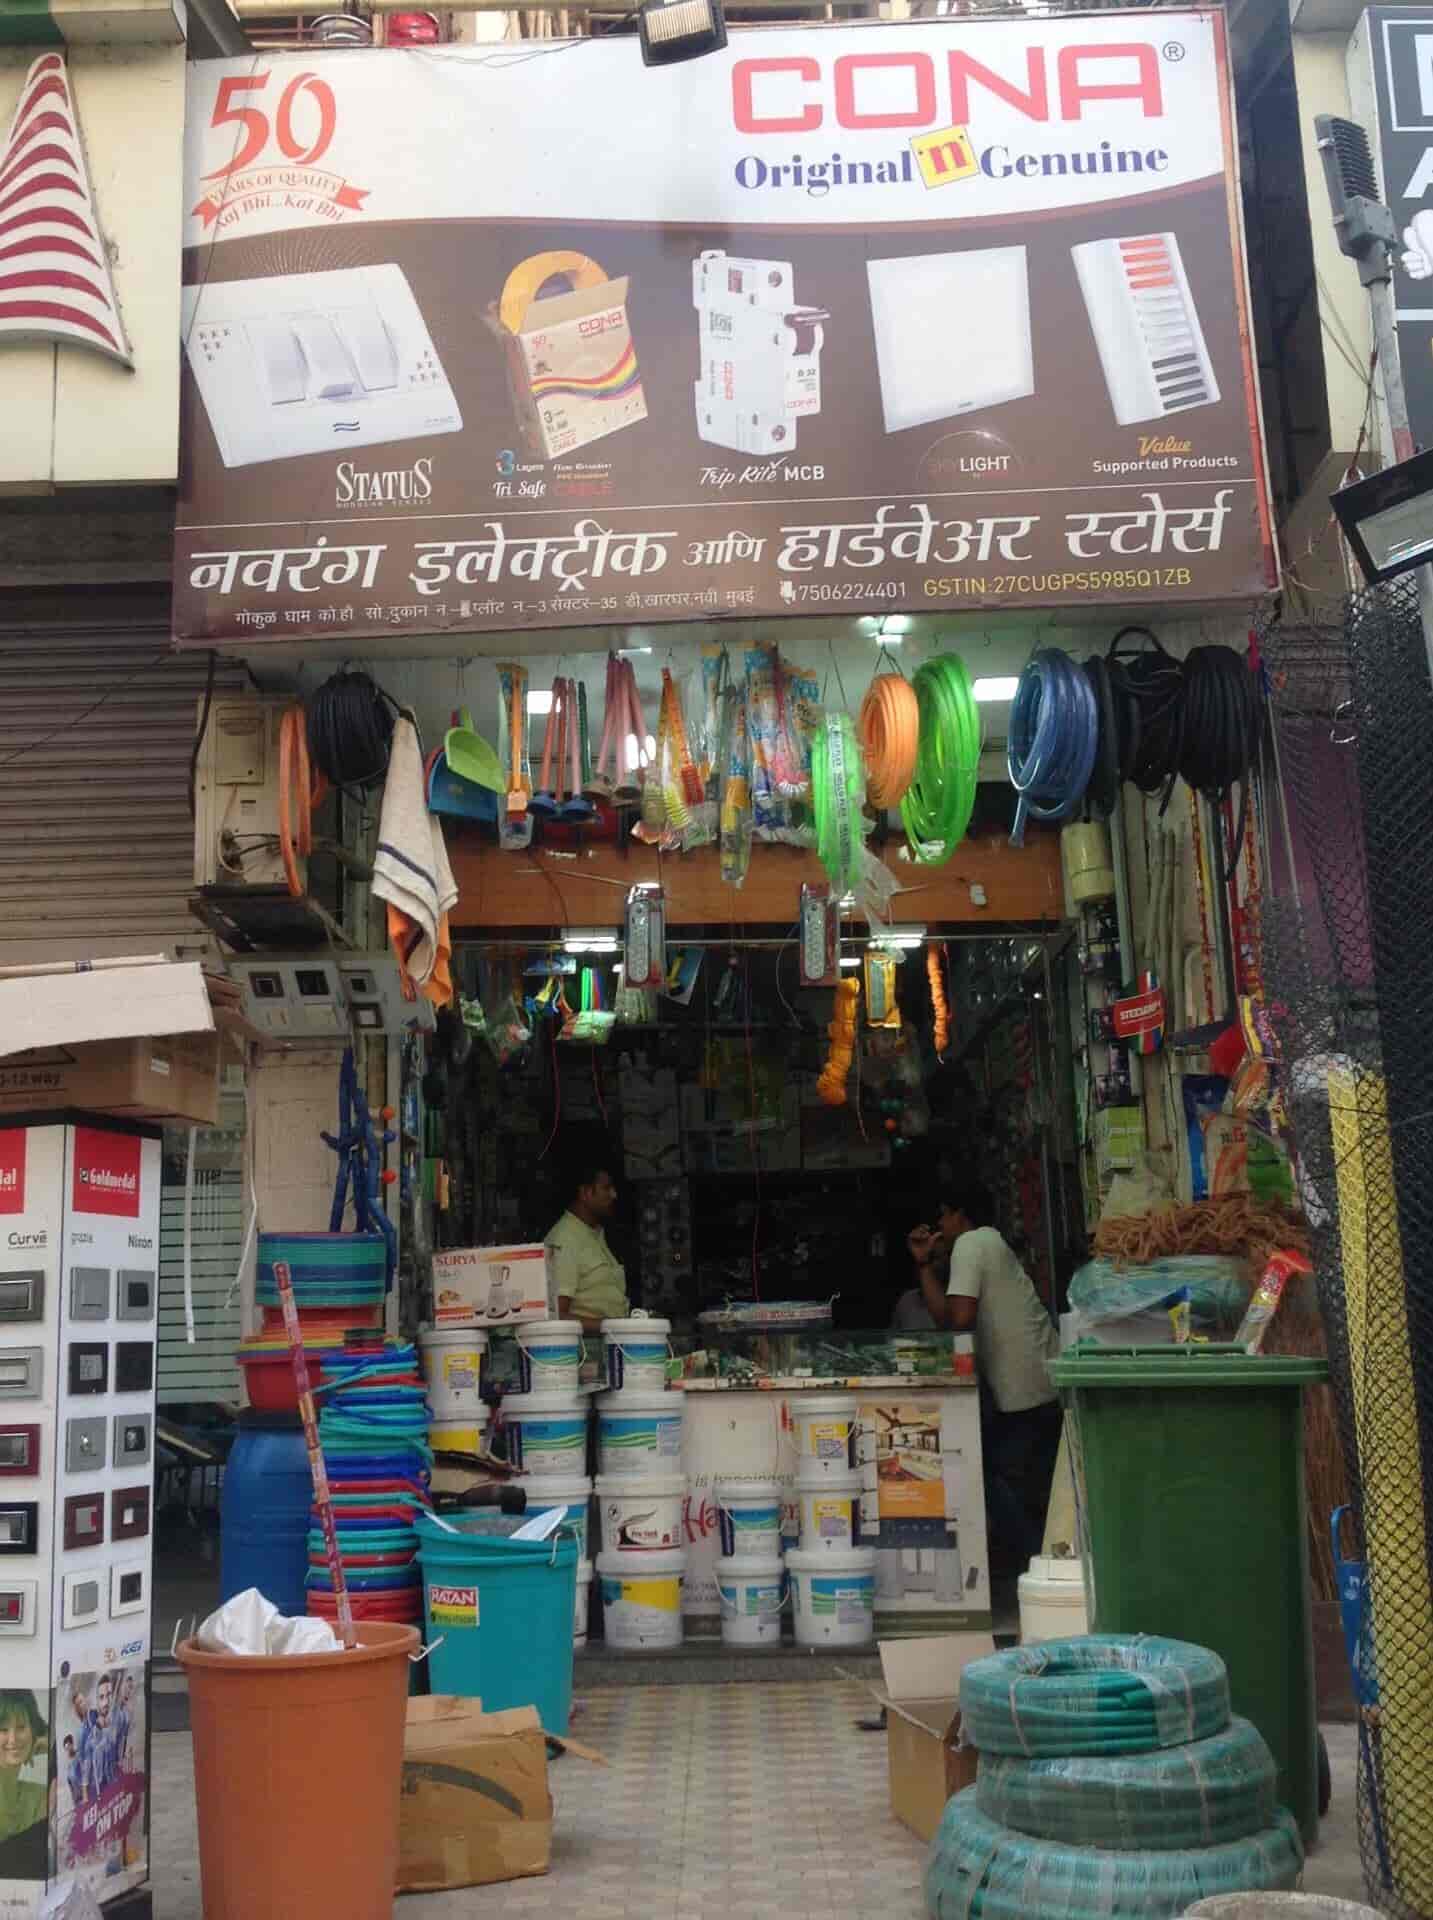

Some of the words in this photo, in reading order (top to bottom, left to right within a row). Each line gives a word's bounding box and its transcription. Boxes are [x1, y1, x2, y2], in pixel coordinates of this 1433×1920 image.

[732, 42, 1163, 134] CONA
[199, 70, 337, 179] 50
[735, 150, 912, 196] Original
[980, 142, 1169, 178] Genuine
[256, 175, 275, 187] OF
[279, 173, 339, 193] QUALITY
[1138, 436, 1193, 456] Value
[1093, 458, 1169, 475] Supported
[1172, 455, 1238, 470] Products
[700, 466, 735, 489] Trip
[784, 465, 825, 481] MCB
[493, 481, 512, 497] Tri
[518, 480, 546, 499] Safe
[189, 536, 388, 595] नवरंग
[682, 531, 769, 567] आणि
[776, 504, 1041, 572] हार्डवेअर
[1064, 489, 1236, 558] स्टोर्स
[799, 580, 907, 601] 7506224401
[90, 1167, 137, 1190] Goldmedal
[436, 1253, 476, 1265] SURYA
